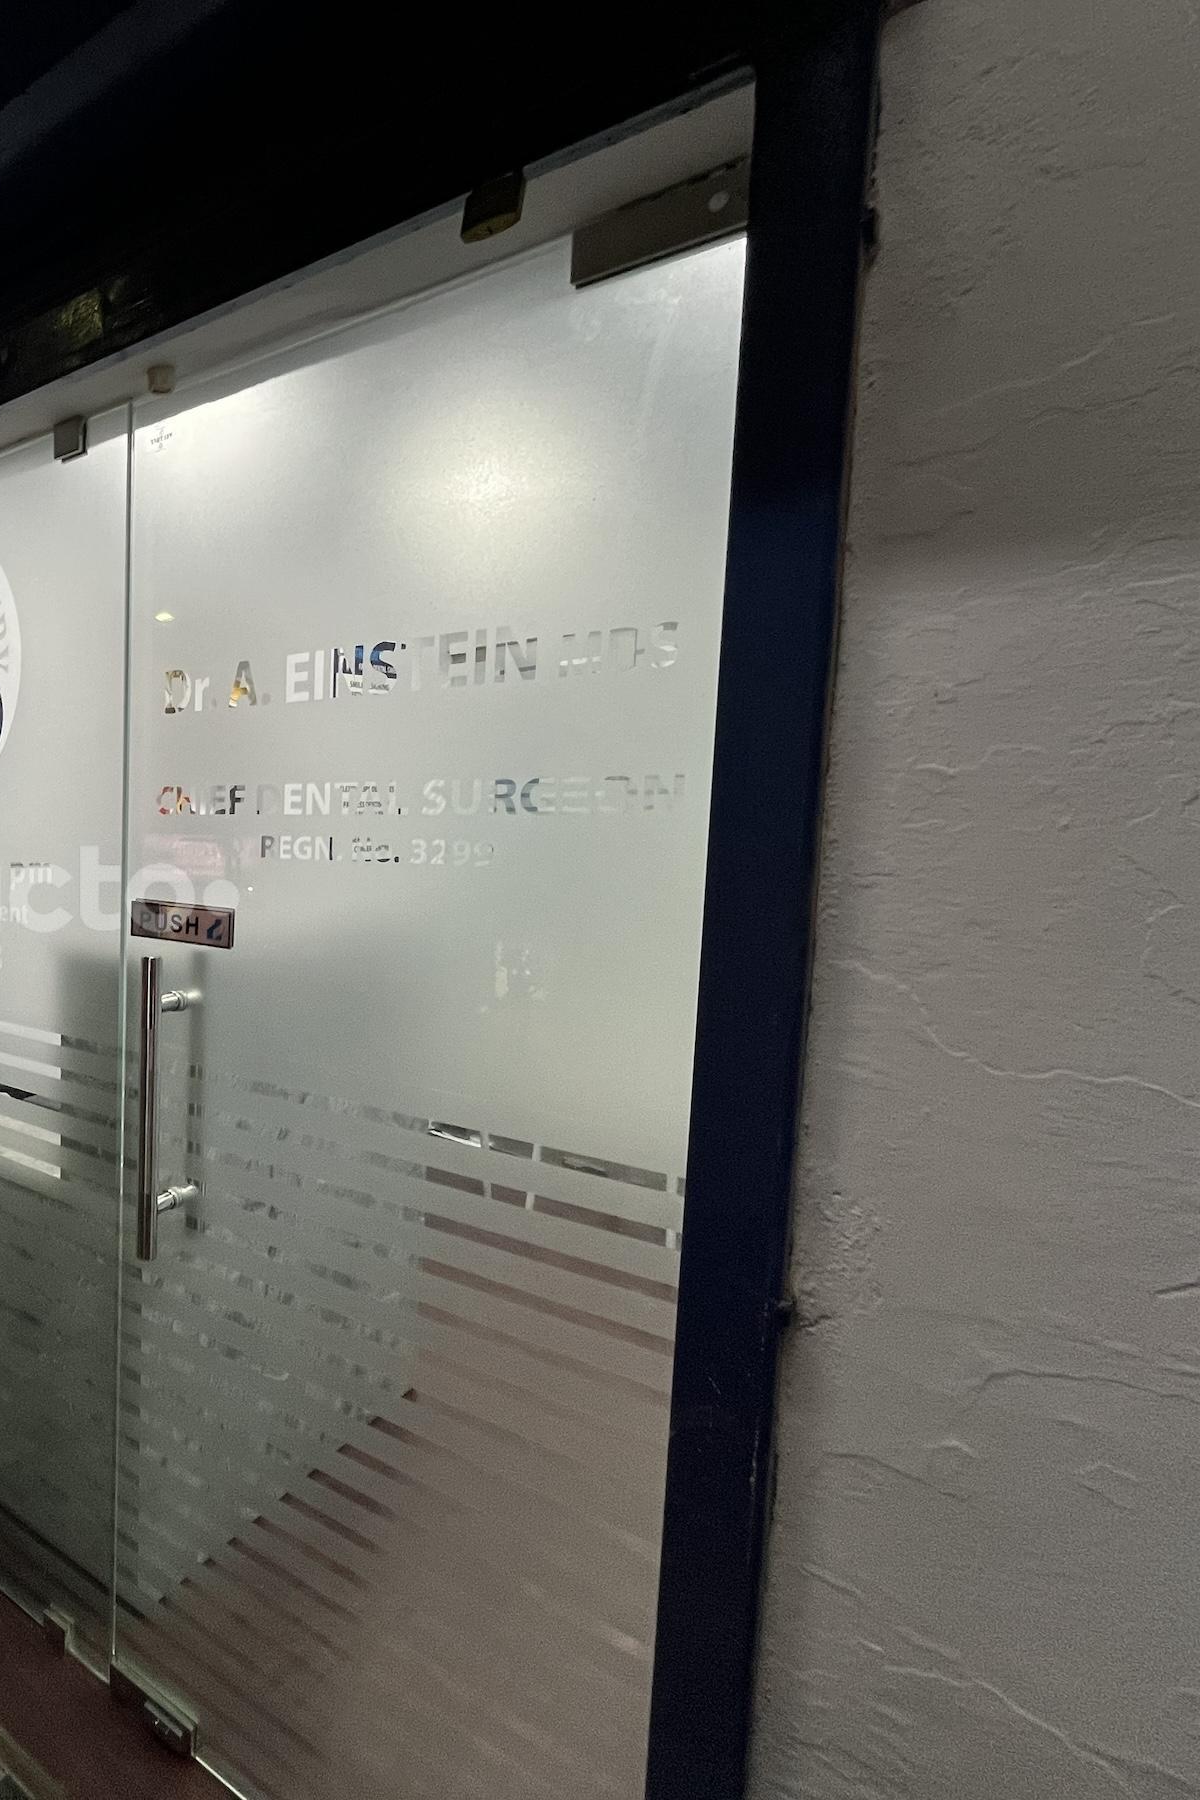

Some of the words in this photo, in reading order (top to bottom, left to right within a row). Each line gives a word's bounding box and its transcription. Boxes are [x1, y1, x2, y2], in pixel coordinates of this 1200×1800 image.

[285, 626, 538, 703] EINSTEIN
[9, 861, 54, 891] pm
[139, 911, 199, 936] PUSH
